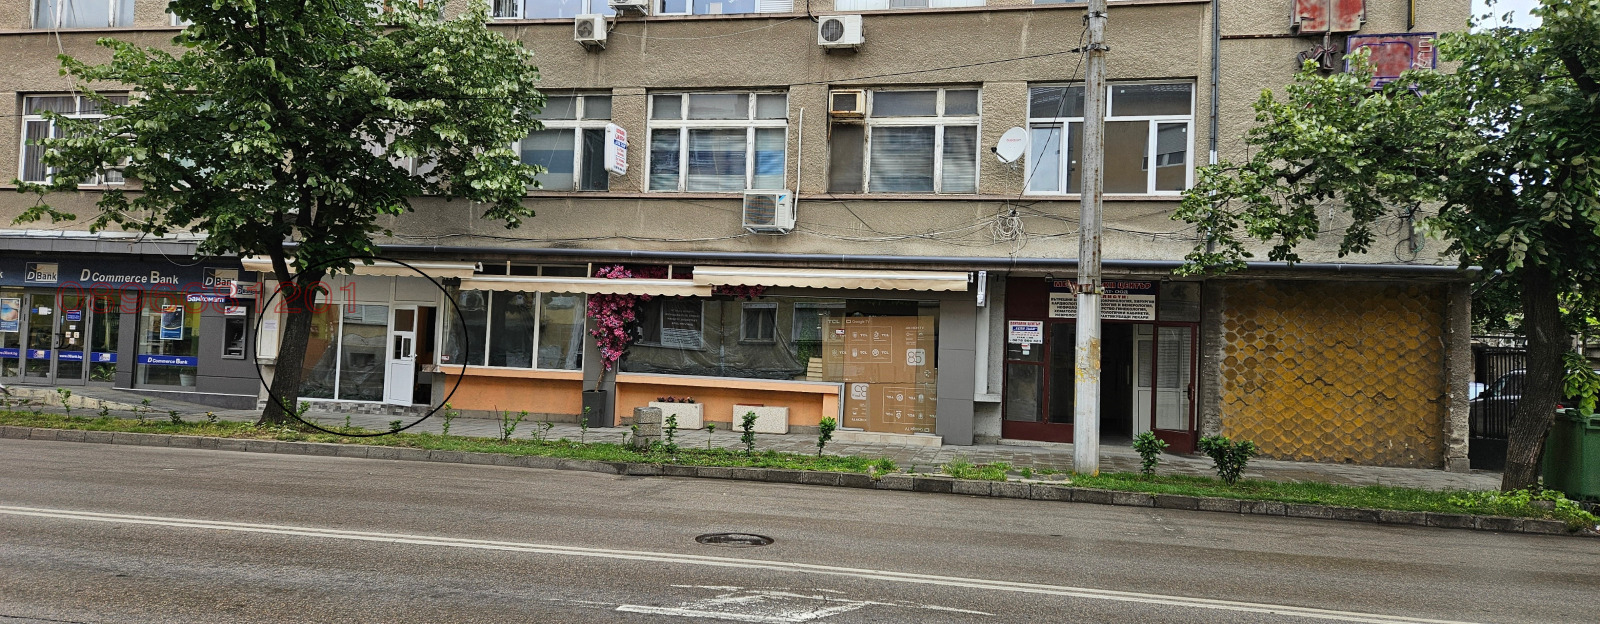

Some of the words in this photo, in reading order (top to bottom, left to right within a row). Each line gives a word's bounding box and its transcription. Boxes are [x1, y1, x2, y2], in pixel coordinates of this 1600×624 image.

[80, 268, 90, 281] D
[92, 272, 148, 283] Commerce
[150, 270, 178, 284] Bank
